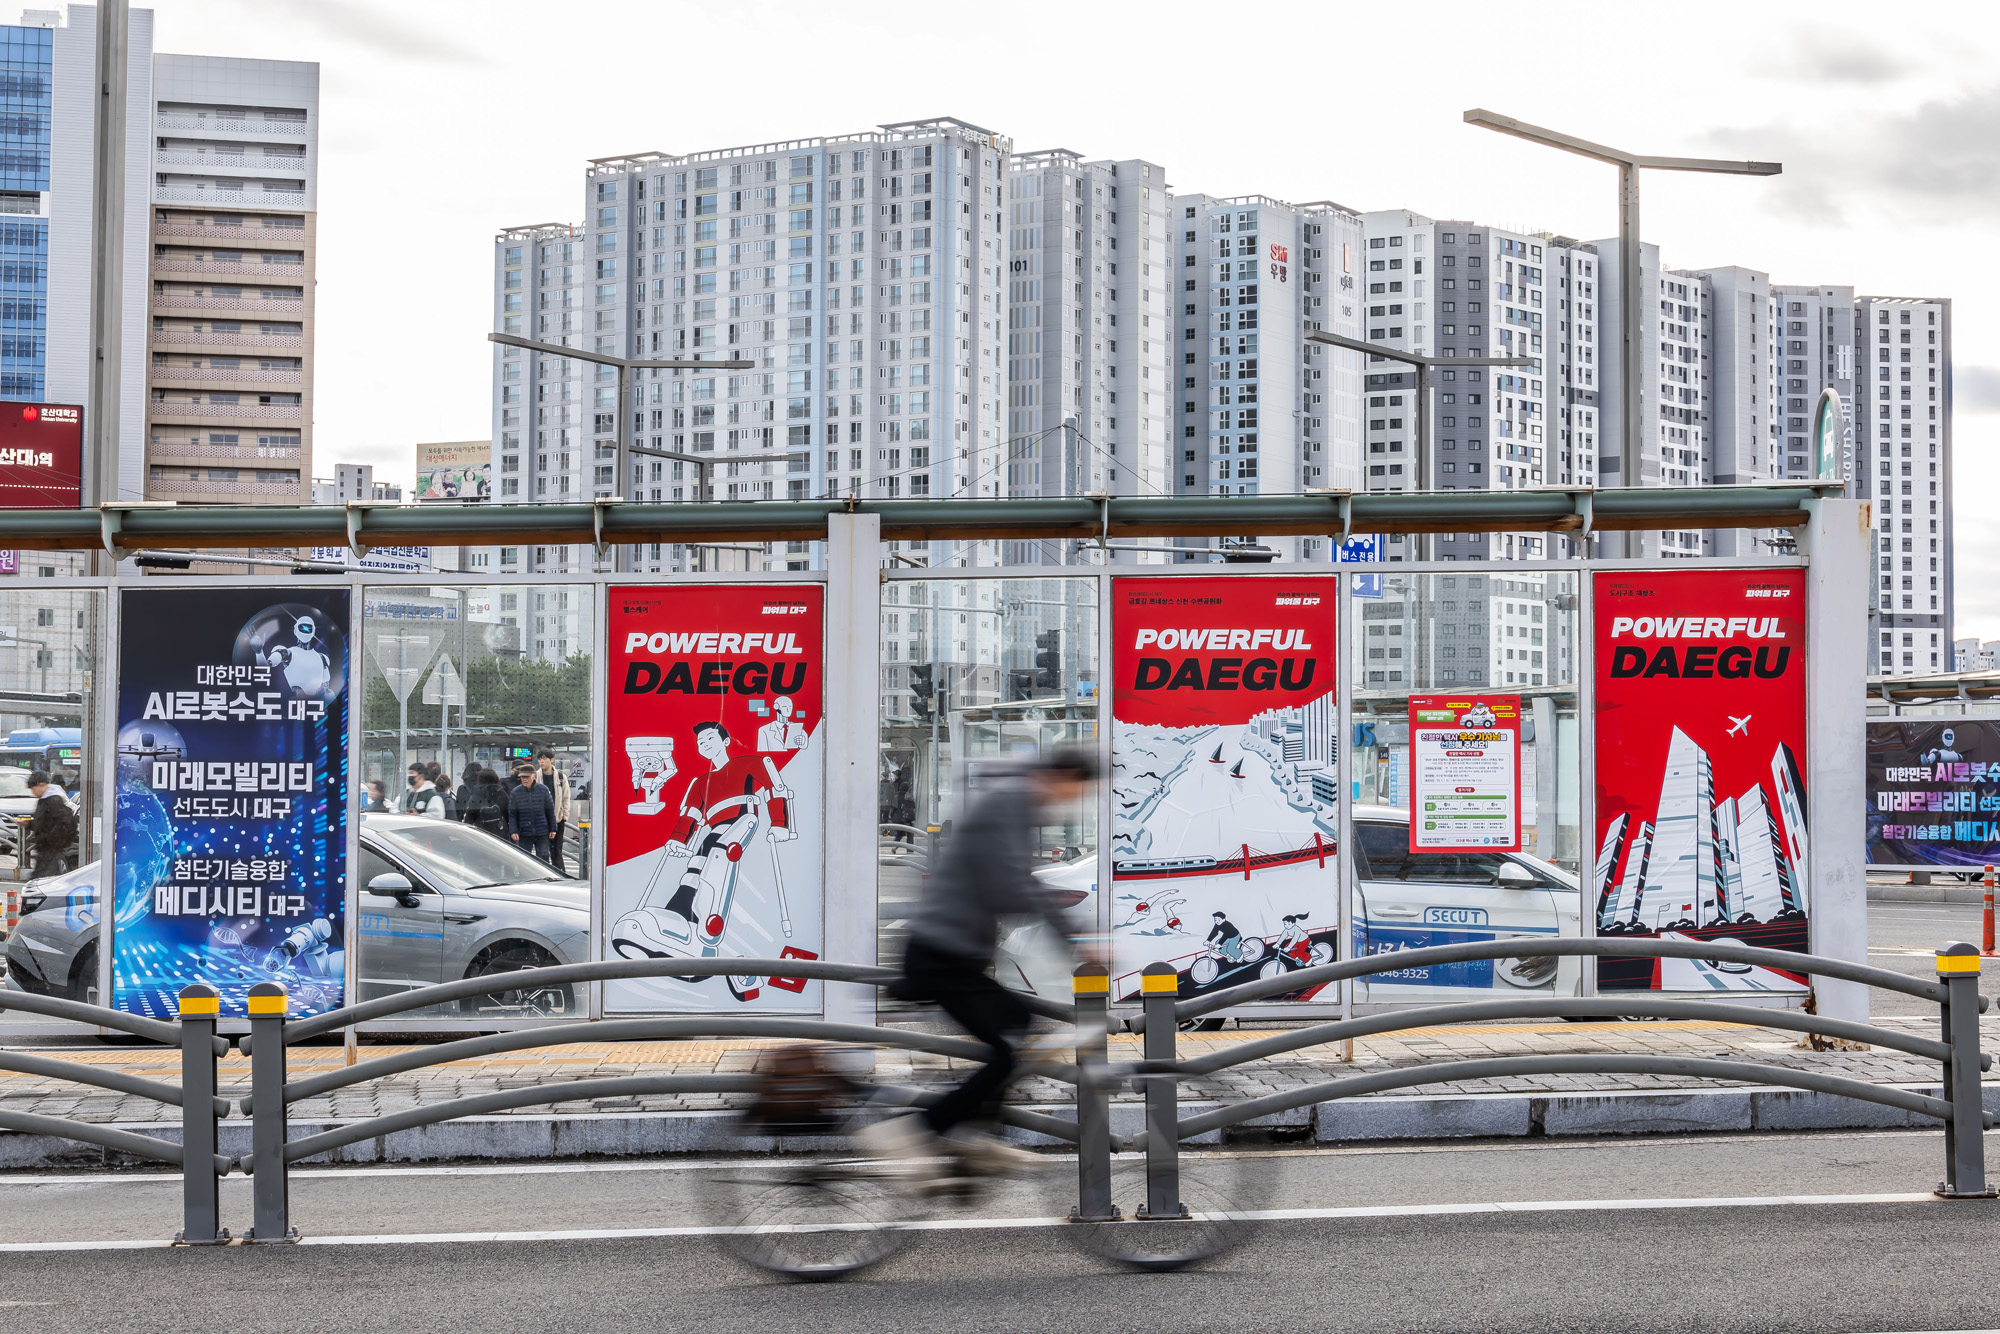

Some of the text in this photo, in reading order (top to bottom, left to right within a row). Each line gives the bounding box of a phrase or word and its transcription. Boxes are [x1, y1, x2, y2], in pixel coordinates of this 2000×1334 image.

[1270, 243, 1287, 263] SM
[1010, 260, 1027, 272] 101
[1270, 263, 1287, 283] 우방
[1342, 305, 1352, 317] 105
[41, 408, 78, 418] 호산대학교
[426, 454, 457, 464] 대성에너지
[1341, 550, 1375, 562] 버스전용
[624, 606, 648, 614] 헬스케어
[762, 606, 807, 614] 파워풀 대구
[1611, 617, 1786, 639] POWERFUL
[625, 632, 803, 654] POWERFUL
[1135, 628, 1312, 651] POWERFUL
[1610, 645, 1791, 680] DAEGU
[197, 665, 272, 686] 대한민국
[623, 661, 808, 695] DAEGU
[1134, 657, 1317, 692] DAEGU
[143, 691, 325, 721] AI로봇수도 대구
[1421, 733, 1443, 741] 친절한
[1443, 733, 1458, 741] 택시
[1459, 732, 1476, 741] 우수
[1464, 740, 1488, 749] 주세요!
[152, 761, 313, 792] 미래모빌리티
[1886, 767, 1932, 782] 대한민국
[173, 797, 291, 819] 선도도시 대구
[1877, 791, 1977, 812] 미래모빌리티
[1882, 824, 1951, 840] 첨단기술융합
[174, 859, 288, 881] 첨단기술융합
[154, 886, 306, 917] 메디시티 대구
[1463, 960, 1487, 970] 자연산
